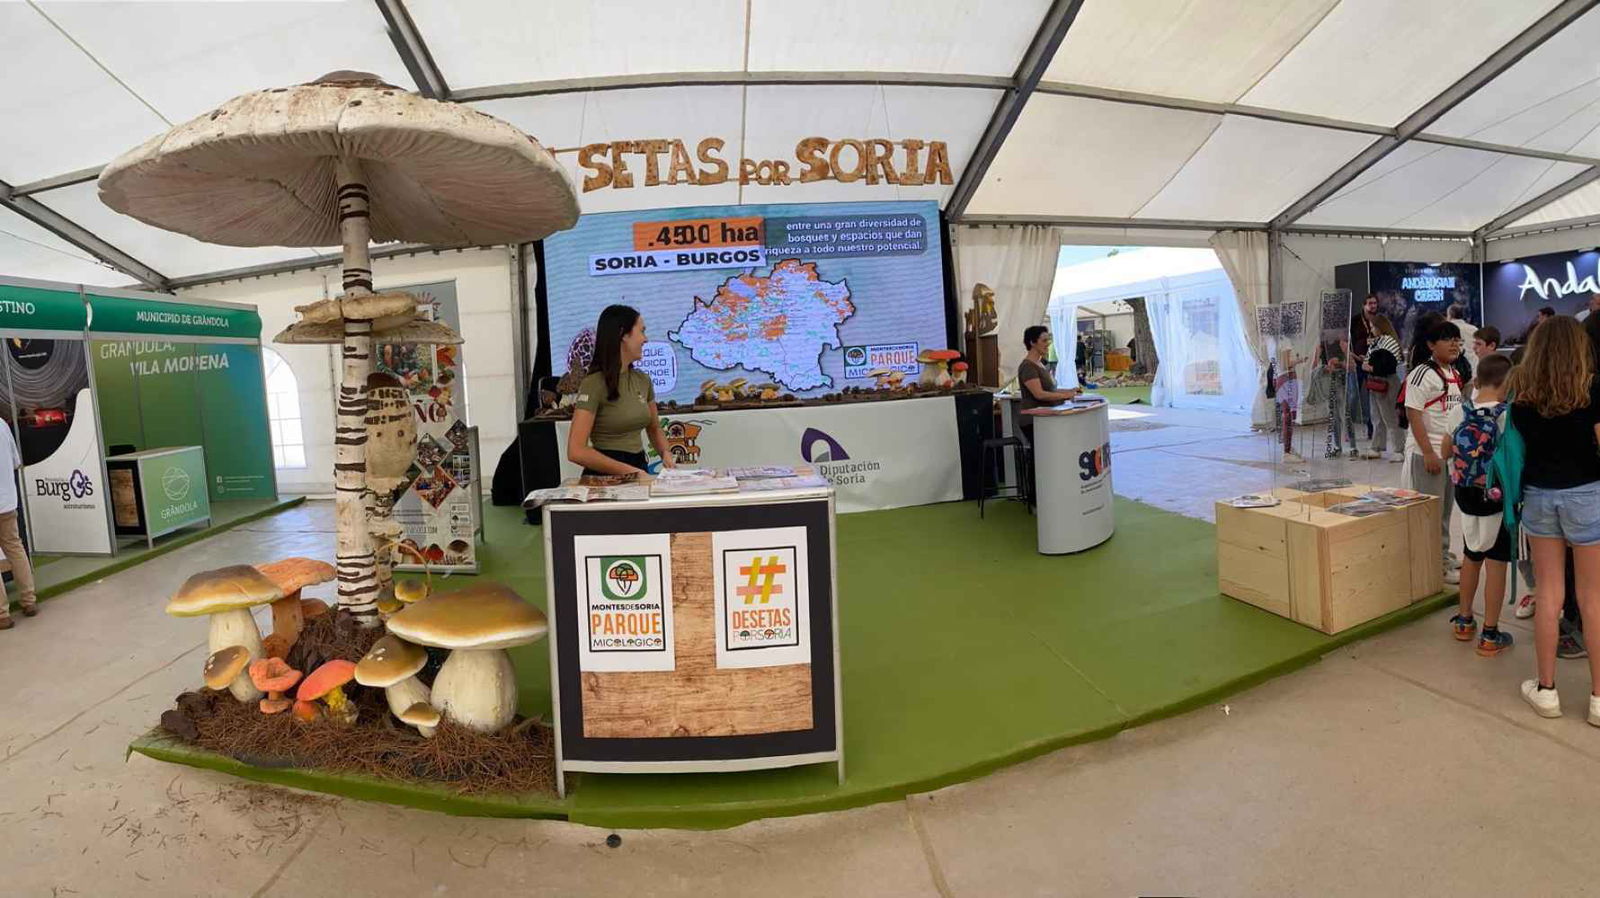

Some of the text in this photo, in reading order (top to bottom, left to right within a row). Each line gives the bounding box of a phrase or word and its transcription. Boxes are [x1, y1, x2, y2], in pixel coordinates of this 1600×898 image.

[578, 136, 954, 193] SETAS POR SORIA
[786, 223, 812, 231] entre
[835, 221, 857, 231] gran
[859, 217, 908, 228] diversidad
[910, 218, 922, 226] de
[788, 232, 829, 243] bosques
[832, 233, 838, 242] y
[840, 230, 883, 241] espacios
[905, 229, 922, 239] dan
[765, 246, 802, 257] riqueza
[813, 244, 835, 254] todo
[838, 242, 875, 252] nuestro
[595, 256, 658, 271] SORIA
[676, 250, 761, 267] BURGOS
[136, 311, 180, 324] MUNICIPIO
[181, 315, 191, 325] DE
[870, 350, 915, 366] PARQUE
[820, 461, 880, 477] Diputación
[836, 474, 866, 486] Soria
[591, 603, 660, 611] MONTESDESORIA
[591, 612, 662, 636] PARQUE
[732, 608, 791, 630] DESETAS
